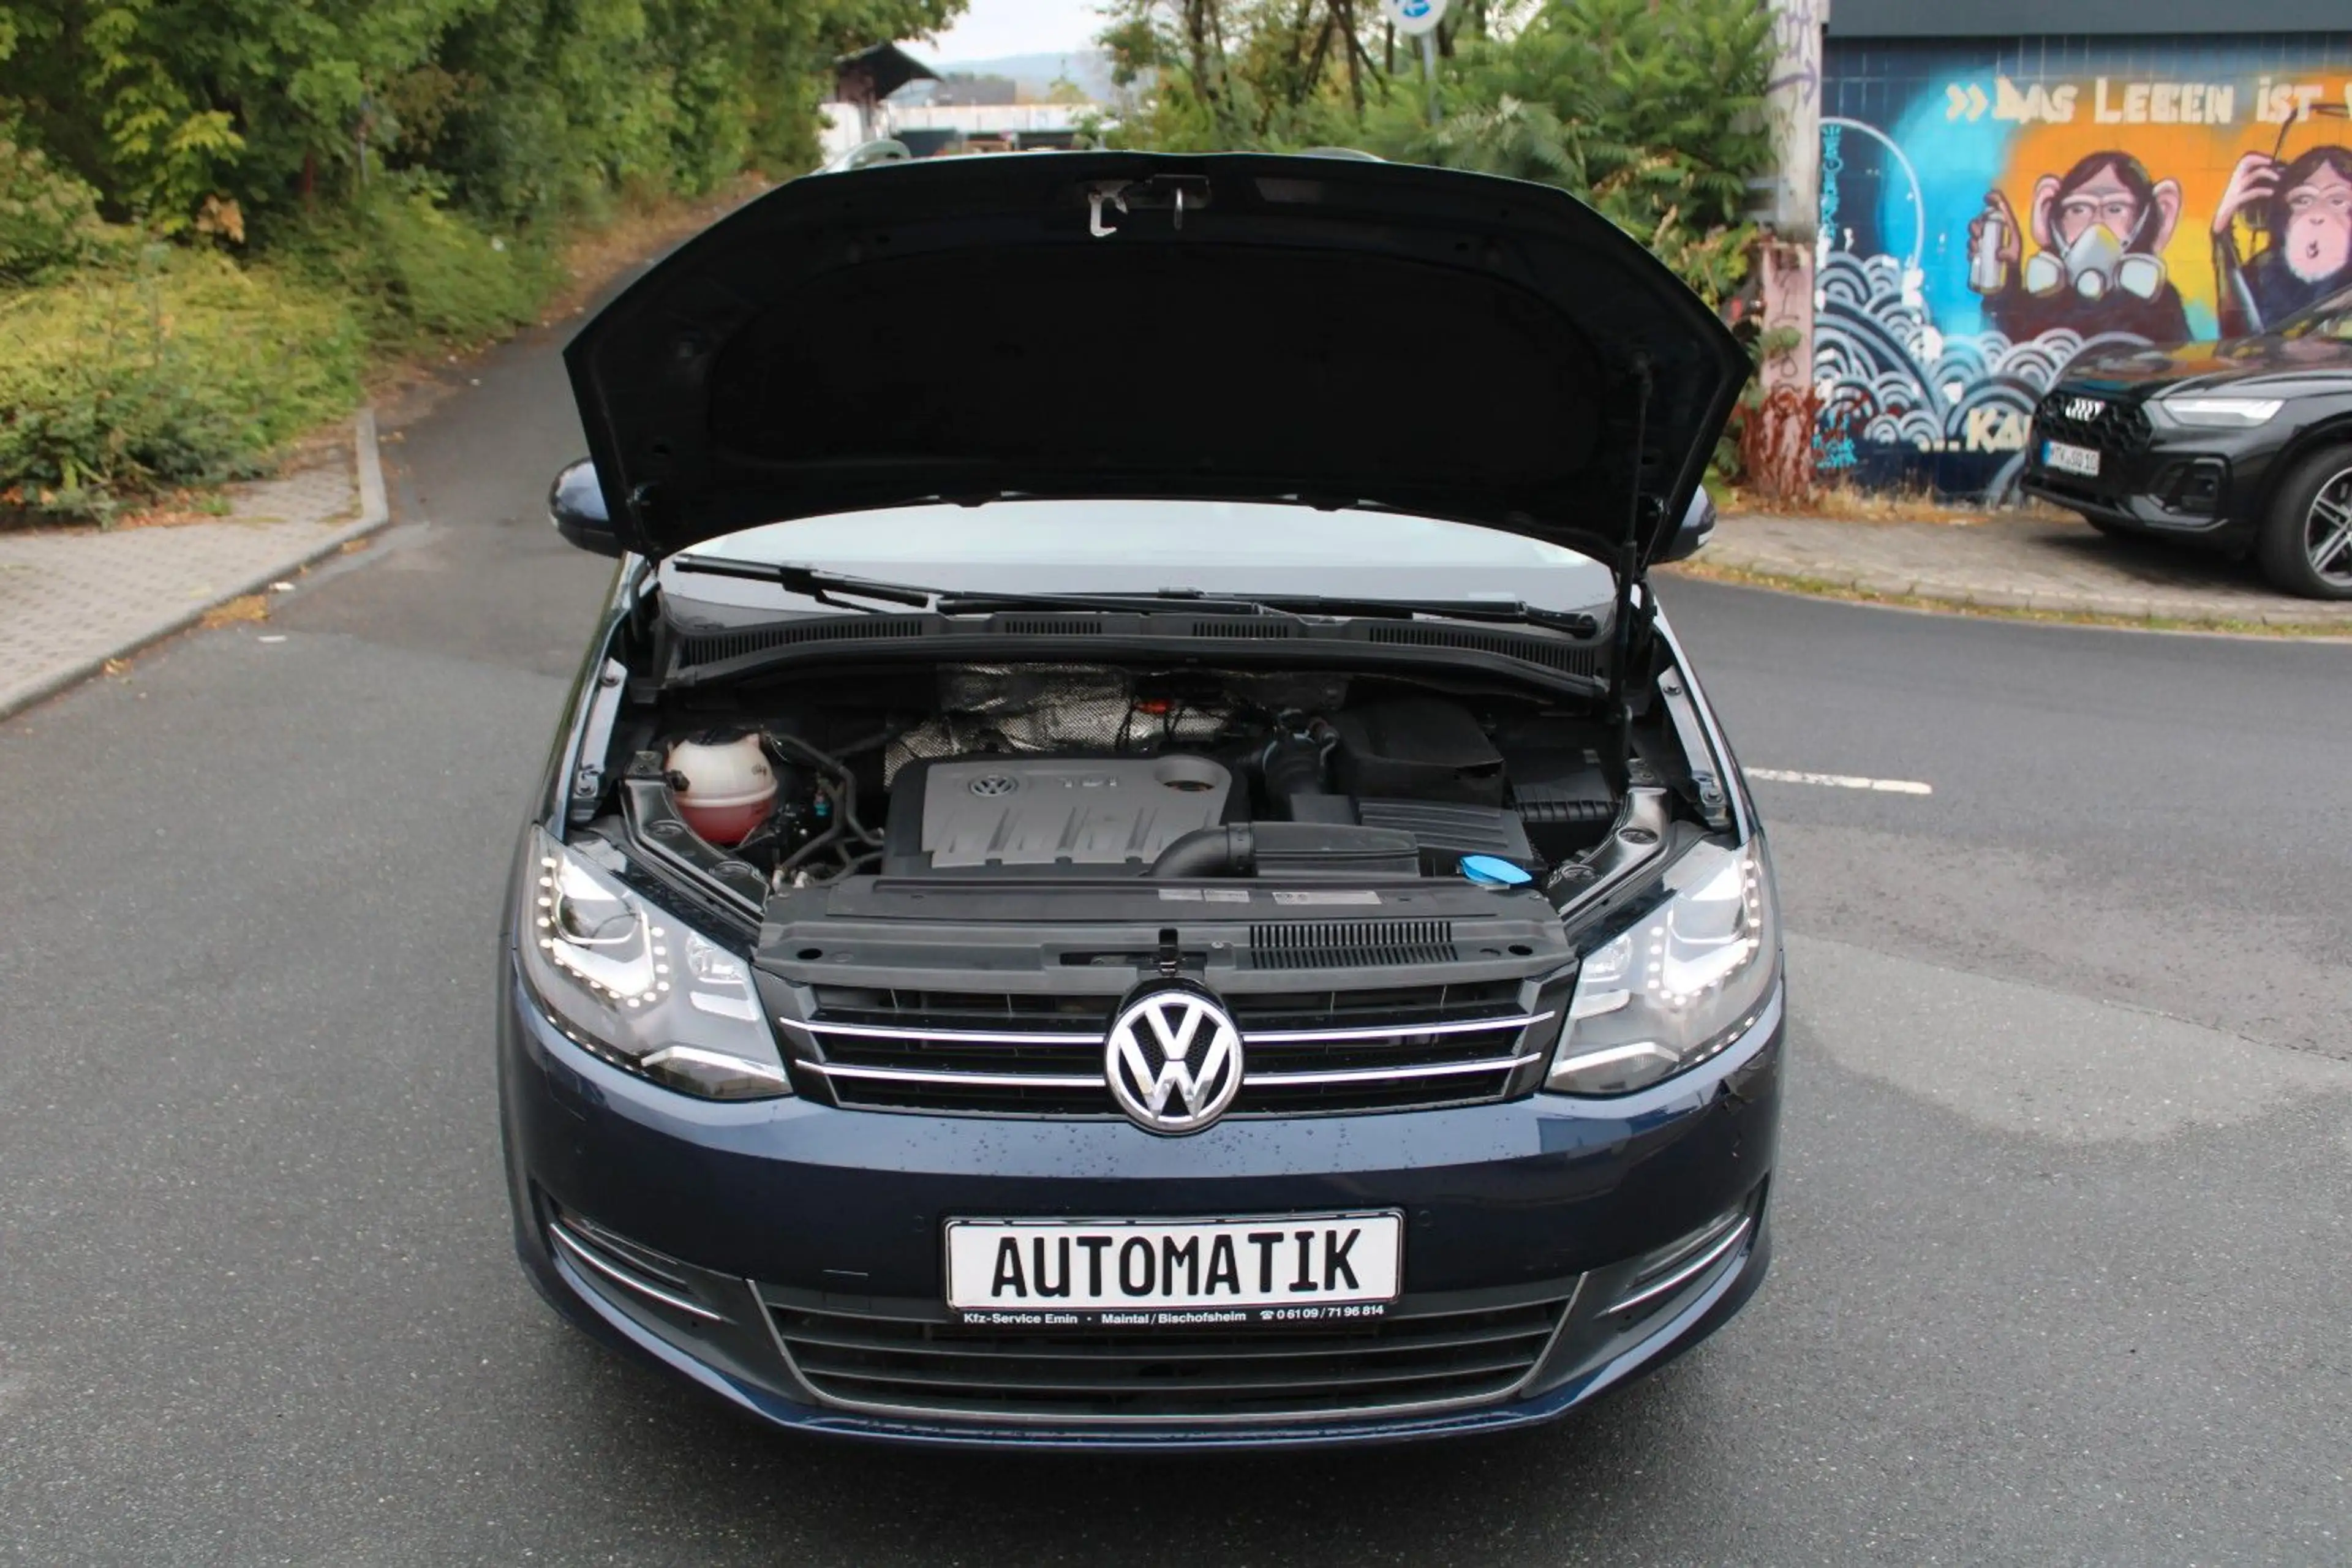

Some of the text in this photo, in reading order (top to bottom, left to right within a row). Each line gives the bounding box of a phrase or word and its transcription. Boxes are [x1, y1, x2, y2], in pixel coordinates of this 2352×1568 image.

[991, 1229, 1362, 1297] AUTOMATIK
[964, 1313, 1041, 1324] Kfz-Service
[1045, 1313, 1077, 1324] Emin
[1102, 1313, 1148, 1324] Maintal
